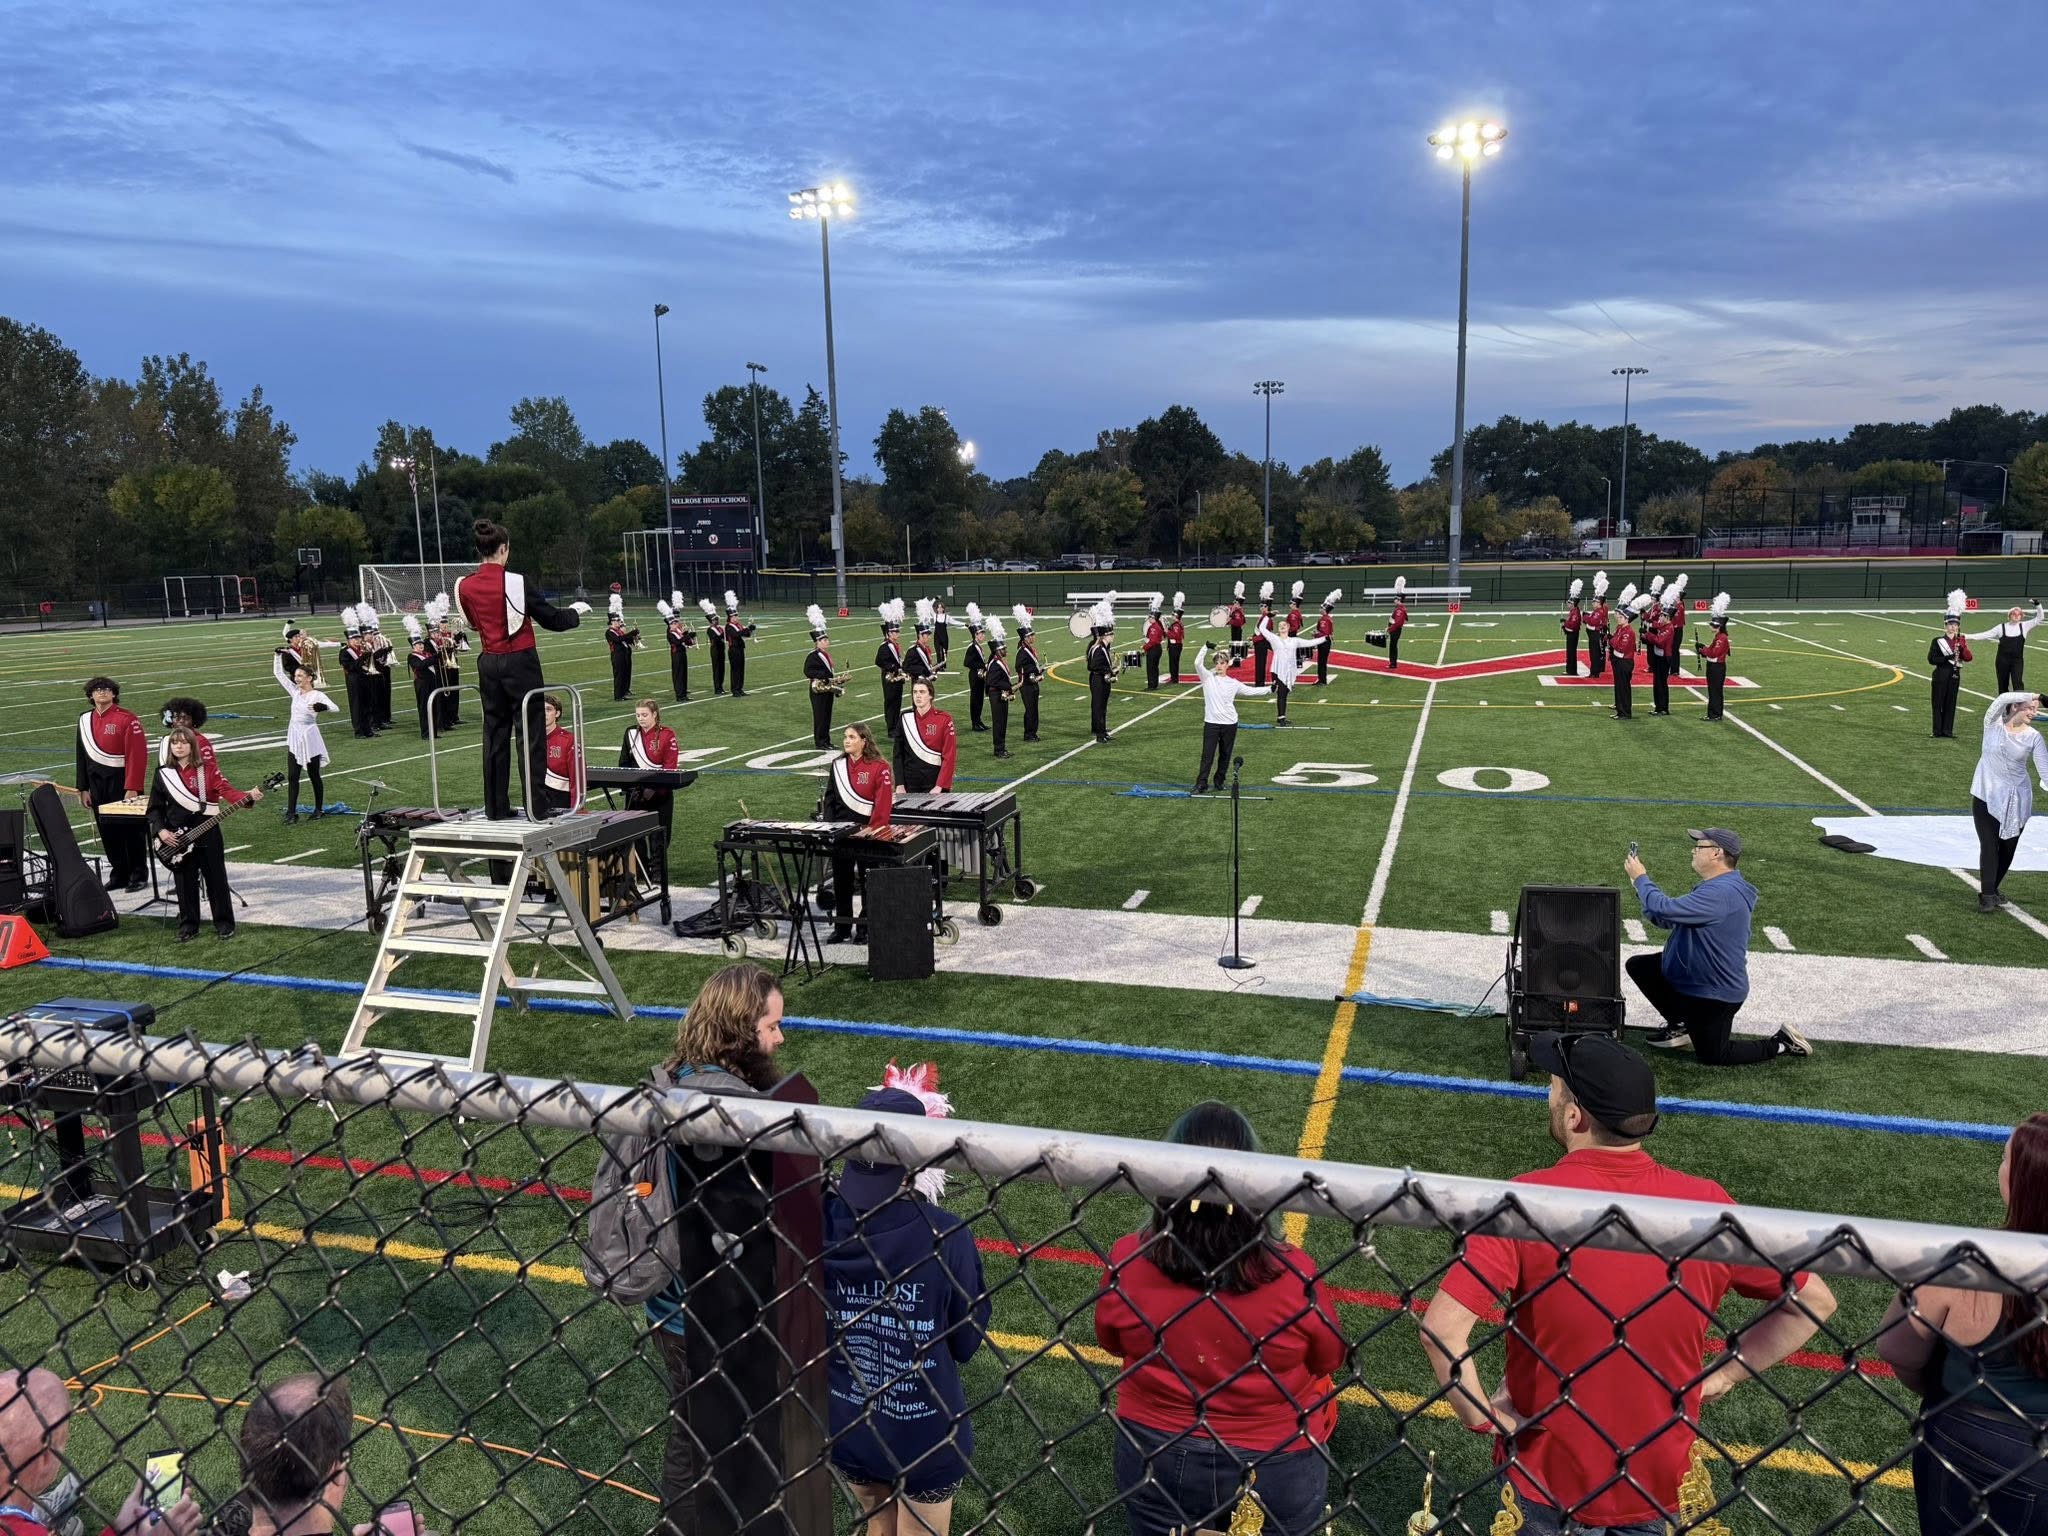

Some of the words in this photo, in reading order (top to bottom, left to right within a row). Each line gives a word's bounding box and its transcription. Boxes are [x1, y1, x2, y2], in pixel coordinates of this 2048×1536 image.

[671, 497, 702, 505] MELROSE
[721, 496, 748, 504] SCHOOL
[881, 1316, 896, 1328] MEL
